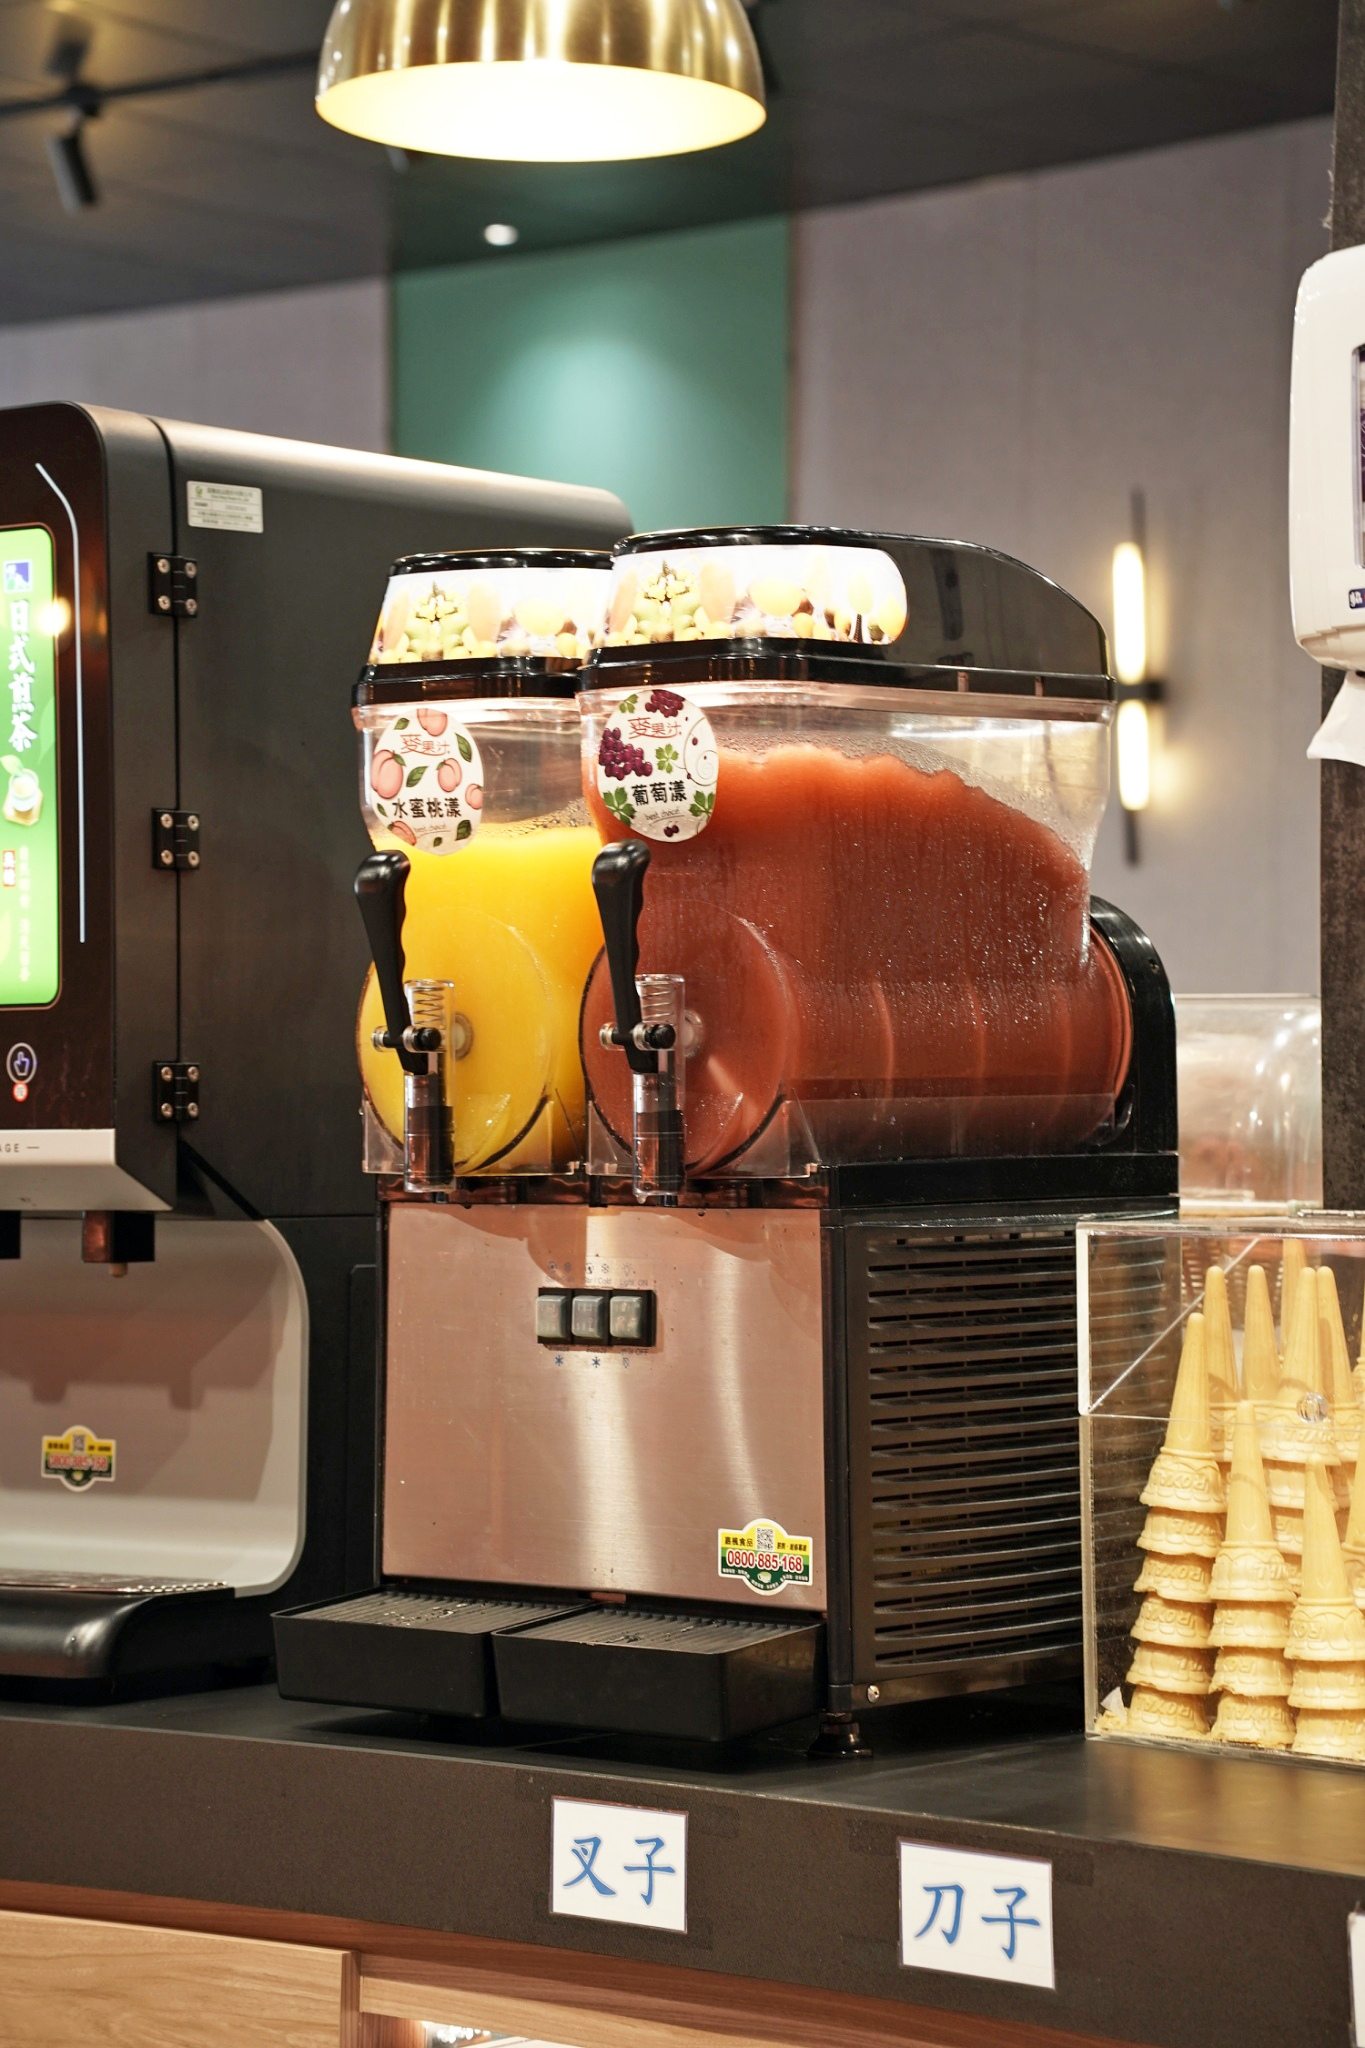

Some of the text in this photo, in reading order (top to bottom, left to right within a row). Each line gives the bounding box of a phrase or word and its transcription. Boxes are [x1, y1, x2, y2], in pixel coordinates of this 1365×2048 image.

[8, 600, 37, 752] 日式煎茶
[392, 797, 462, 818] 水蜜桃漾
[631, 780, 688, 806] 葡萄漾
[563, 1836, 675, 1905] 叉子
[915, 1884, 1040, 1960] 刀子
